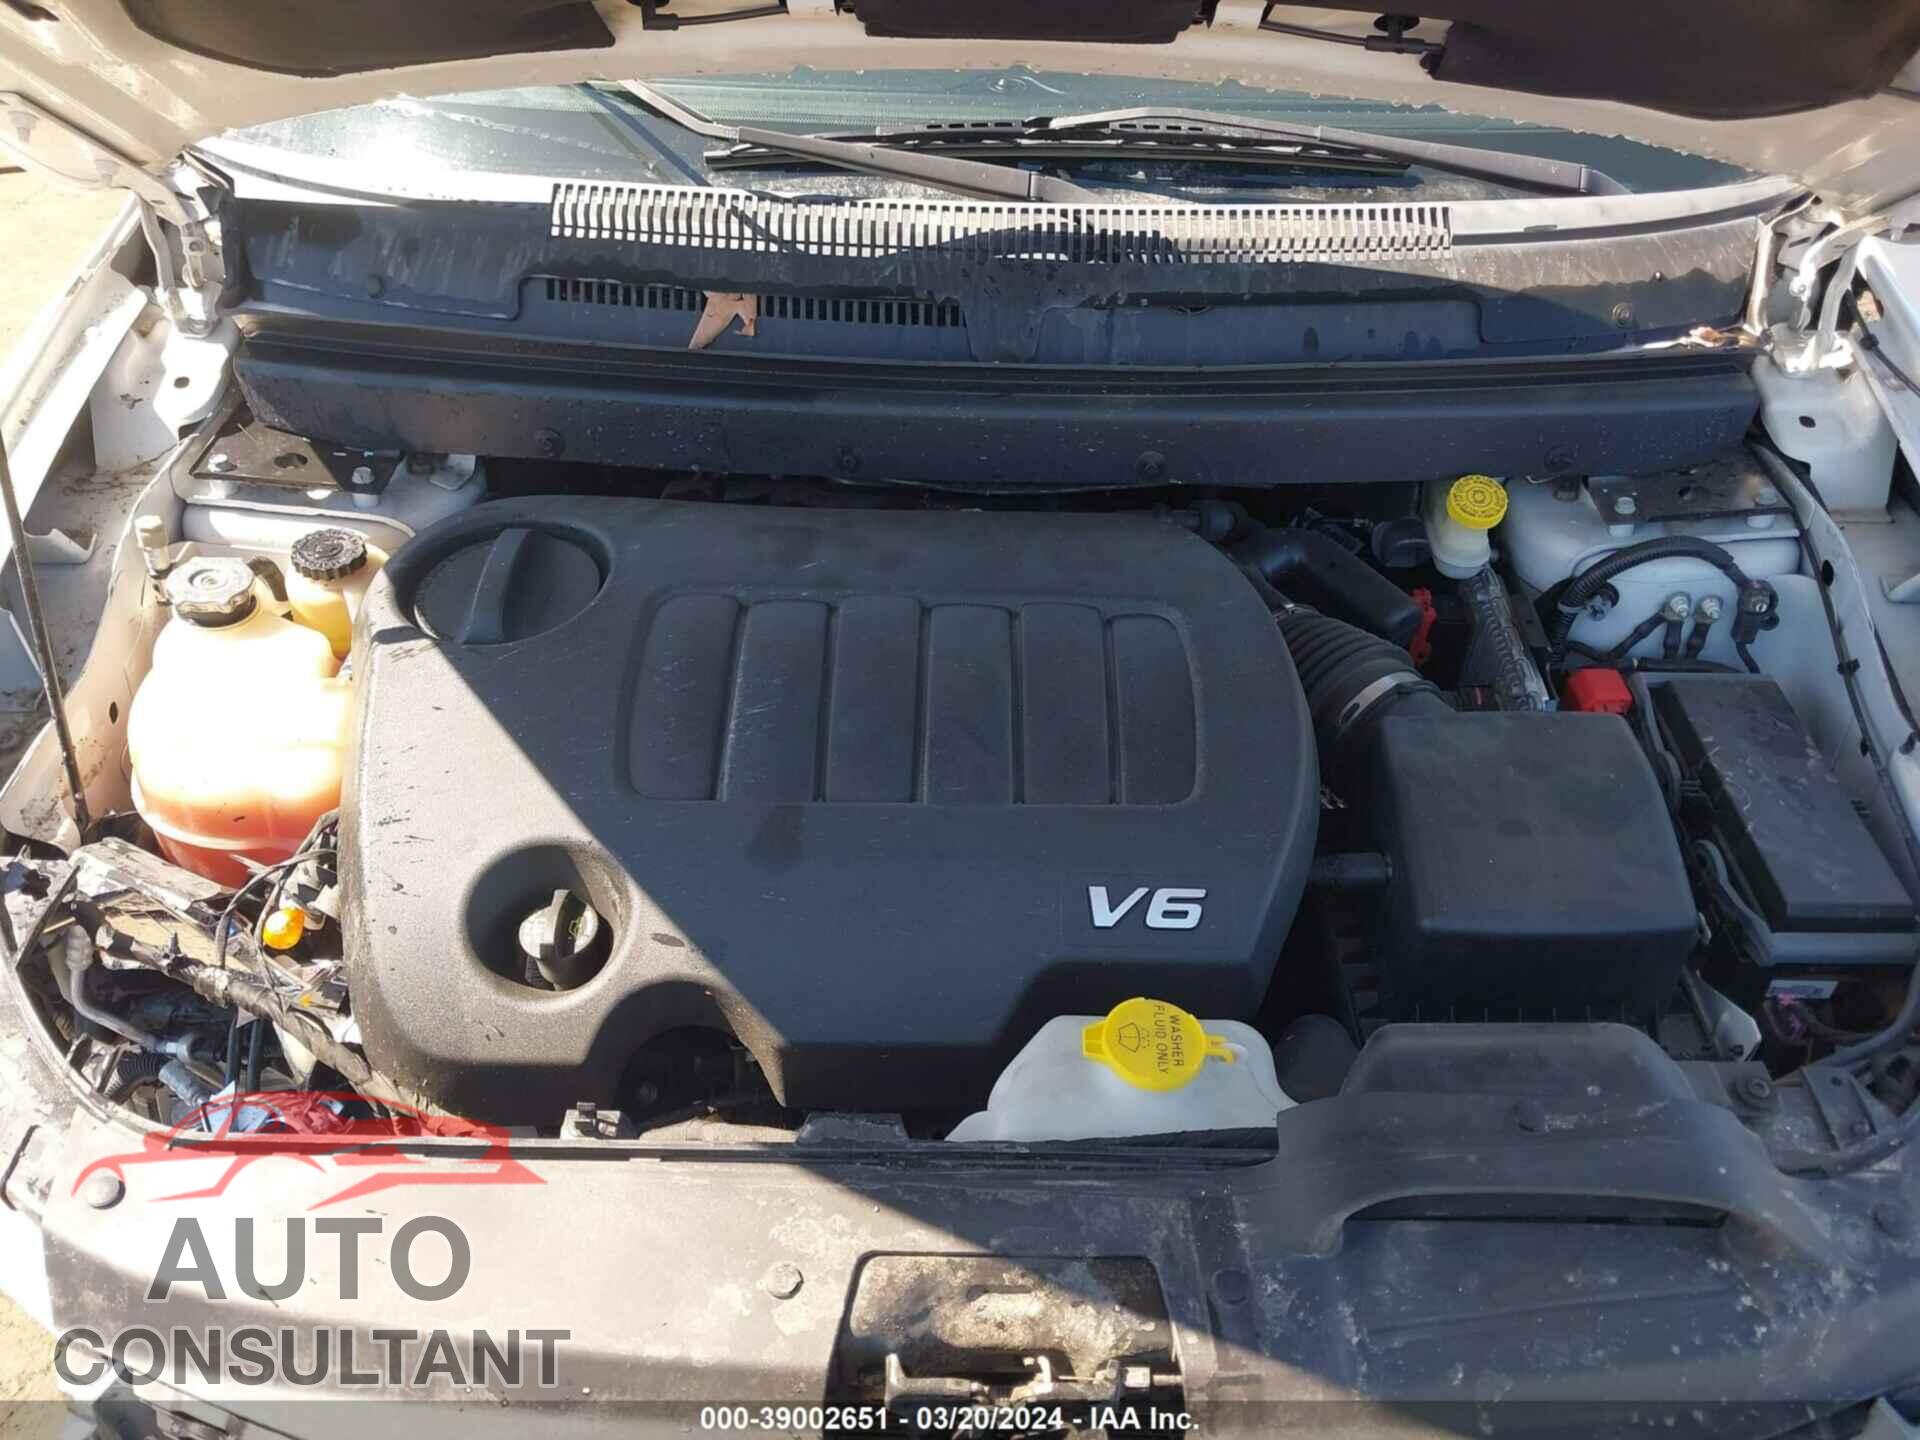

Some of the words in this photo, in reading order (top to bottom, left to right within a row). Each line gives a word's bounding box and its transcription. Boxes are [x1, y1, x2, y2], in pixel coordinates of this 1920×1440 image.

[1088, 885, 1208, 930] V6
[1153, 1003, 1168, 1039] FLUID
[1168, 1013, 1185, 1067] WASHER
[1155, 1042, 1169, 1075] ONLY
